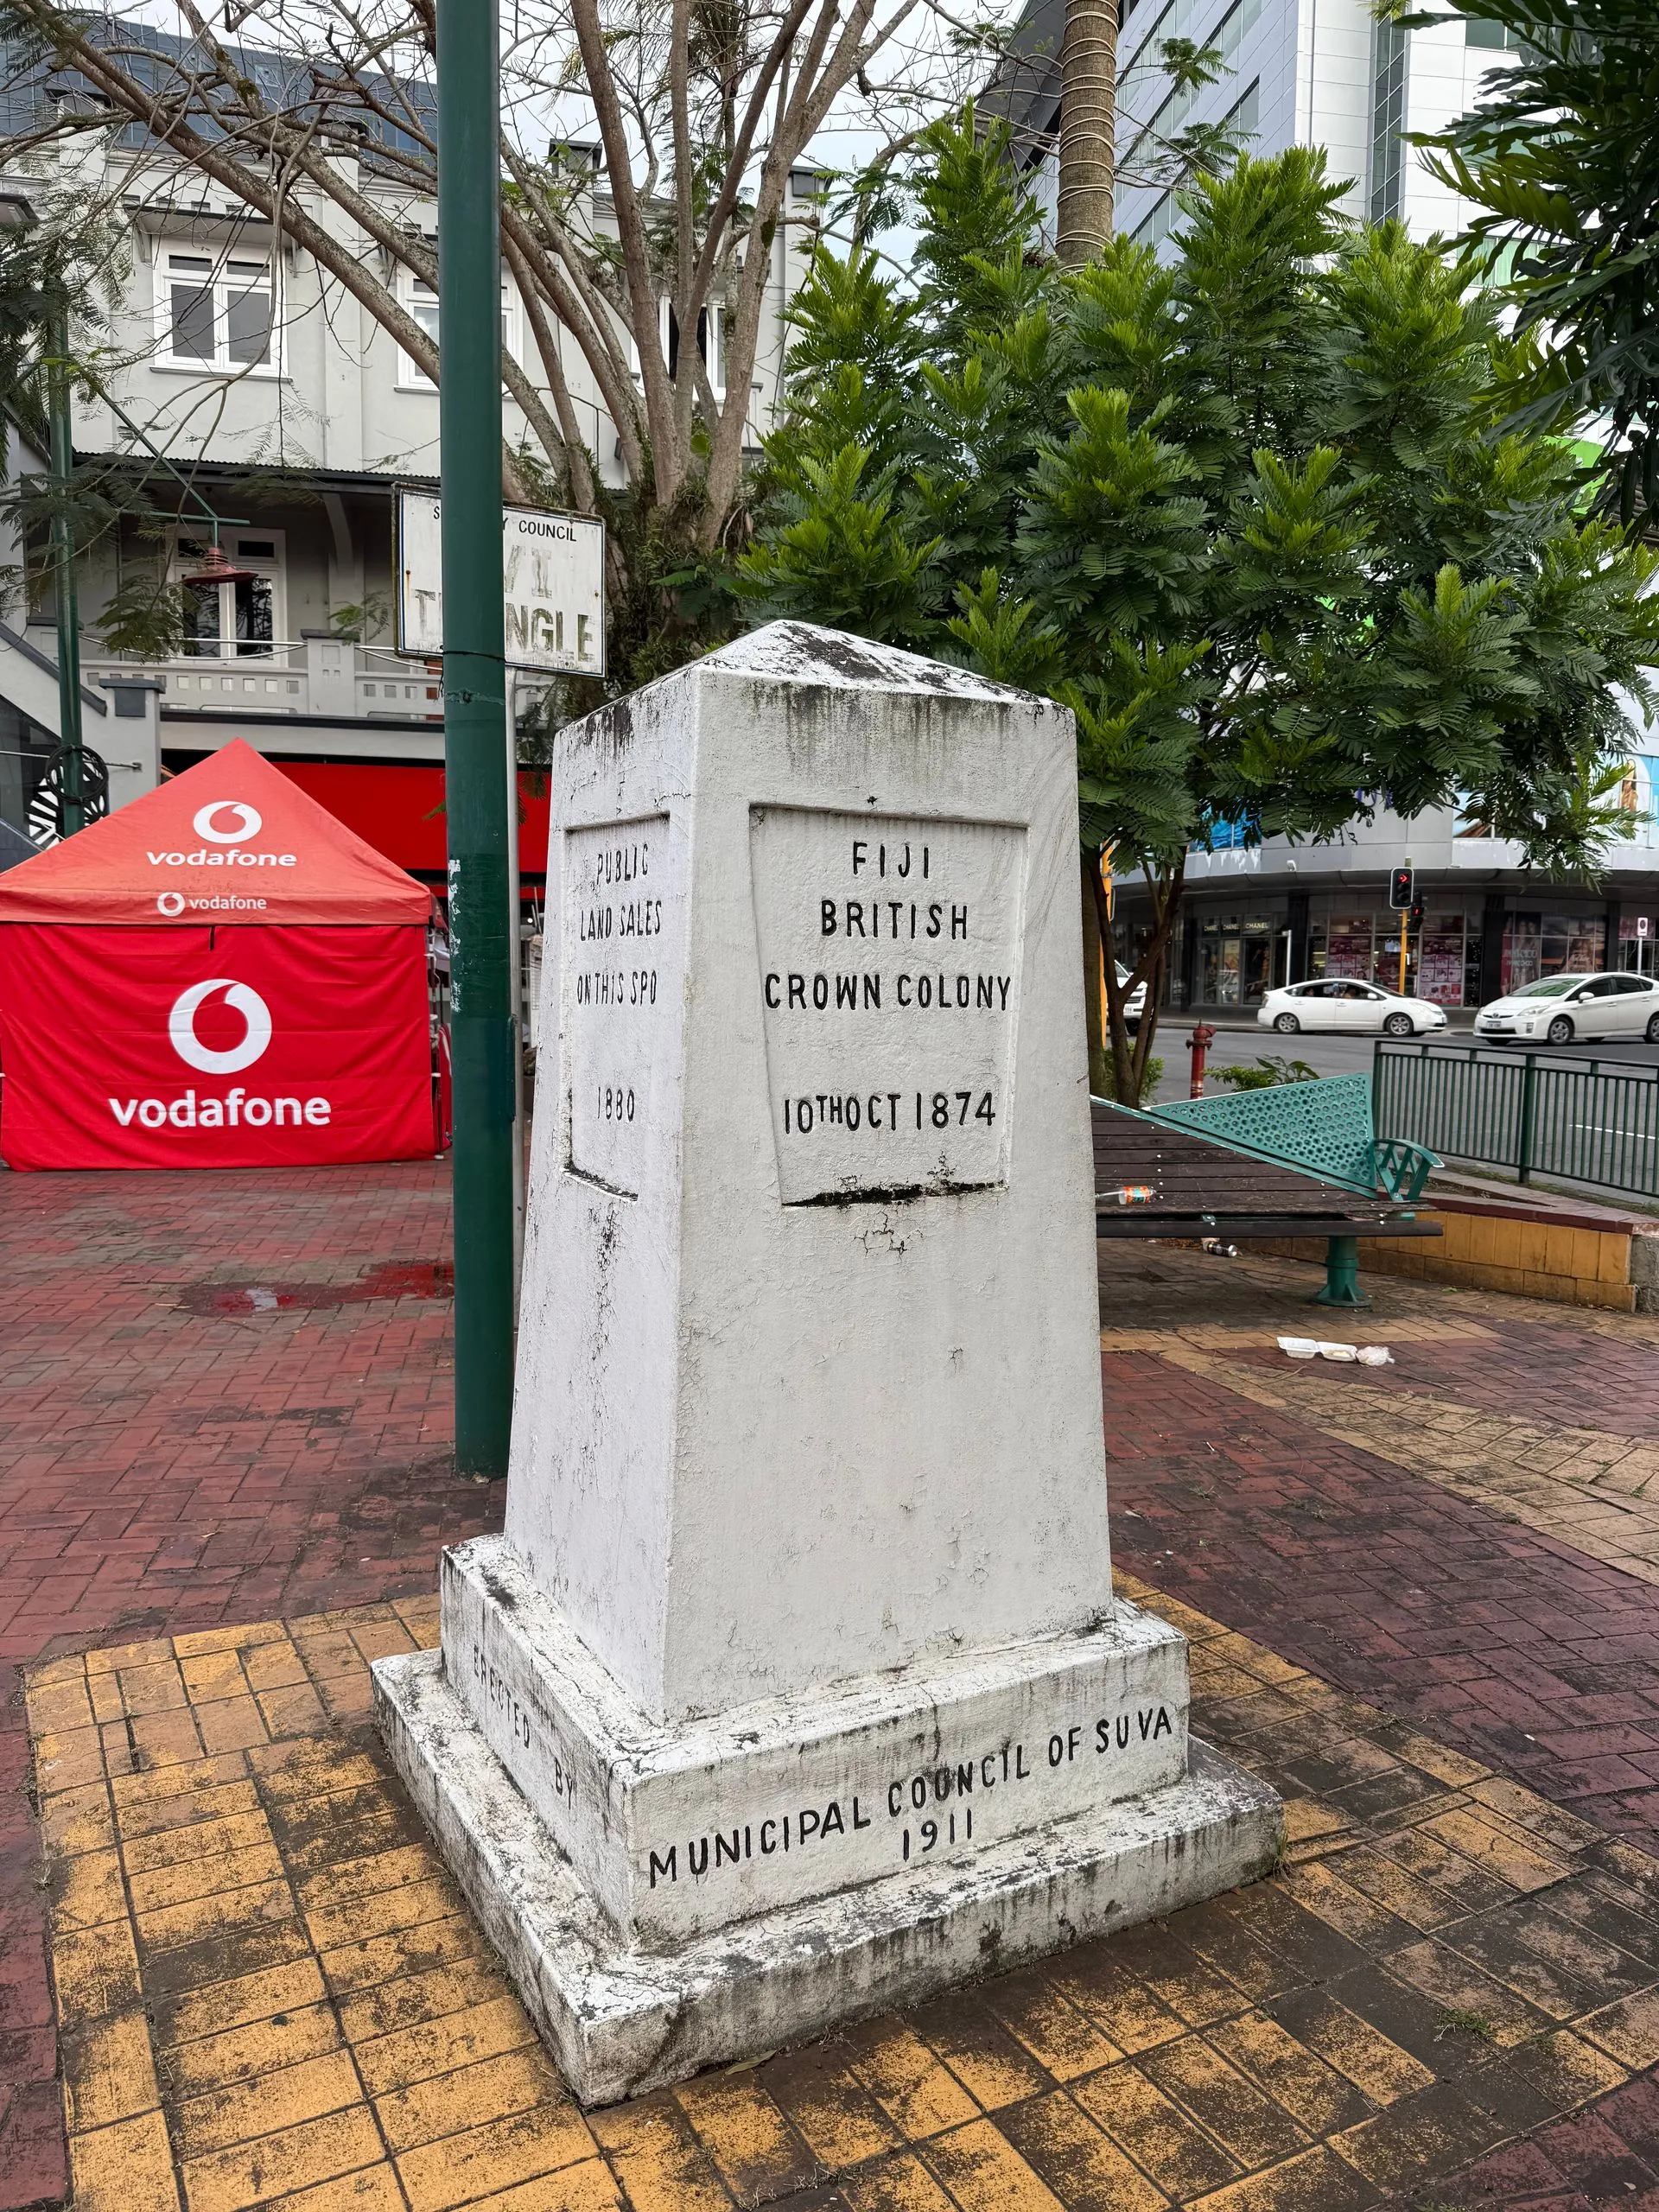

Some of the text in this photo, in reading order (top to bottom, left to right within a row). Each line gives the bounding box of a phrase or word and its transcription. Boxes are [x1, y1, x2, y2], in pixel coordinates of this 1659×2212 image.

[518, 520, 577, 542] COUNCIL
[146, 849, 297, 867] vodafone
[597, 843, 648, 885] PUBLIC
[853, 841, 930, 879] FIJI
[189, 895, 267, 910] vodafone
[581, 900, 662, 942] LAND SALES
[821, 899, 968, 940] BRITISH
[577, 970, 657, 1006] ON THIS SPO
[766, 974, 1011, 1010] CROWN COLONY
[109, 1089, 332, 1128] vodafone
[597, 1086, 635, 1122] 1880
[916, 1092, 995, 1130] 1874
[474, 1644, 573, 1810] ERECTED BY
[649, 1707, 1172, 1889] MUNICIPAL COUNCIL OF SUVA
[903, 1808, 973, 1862] 1911
